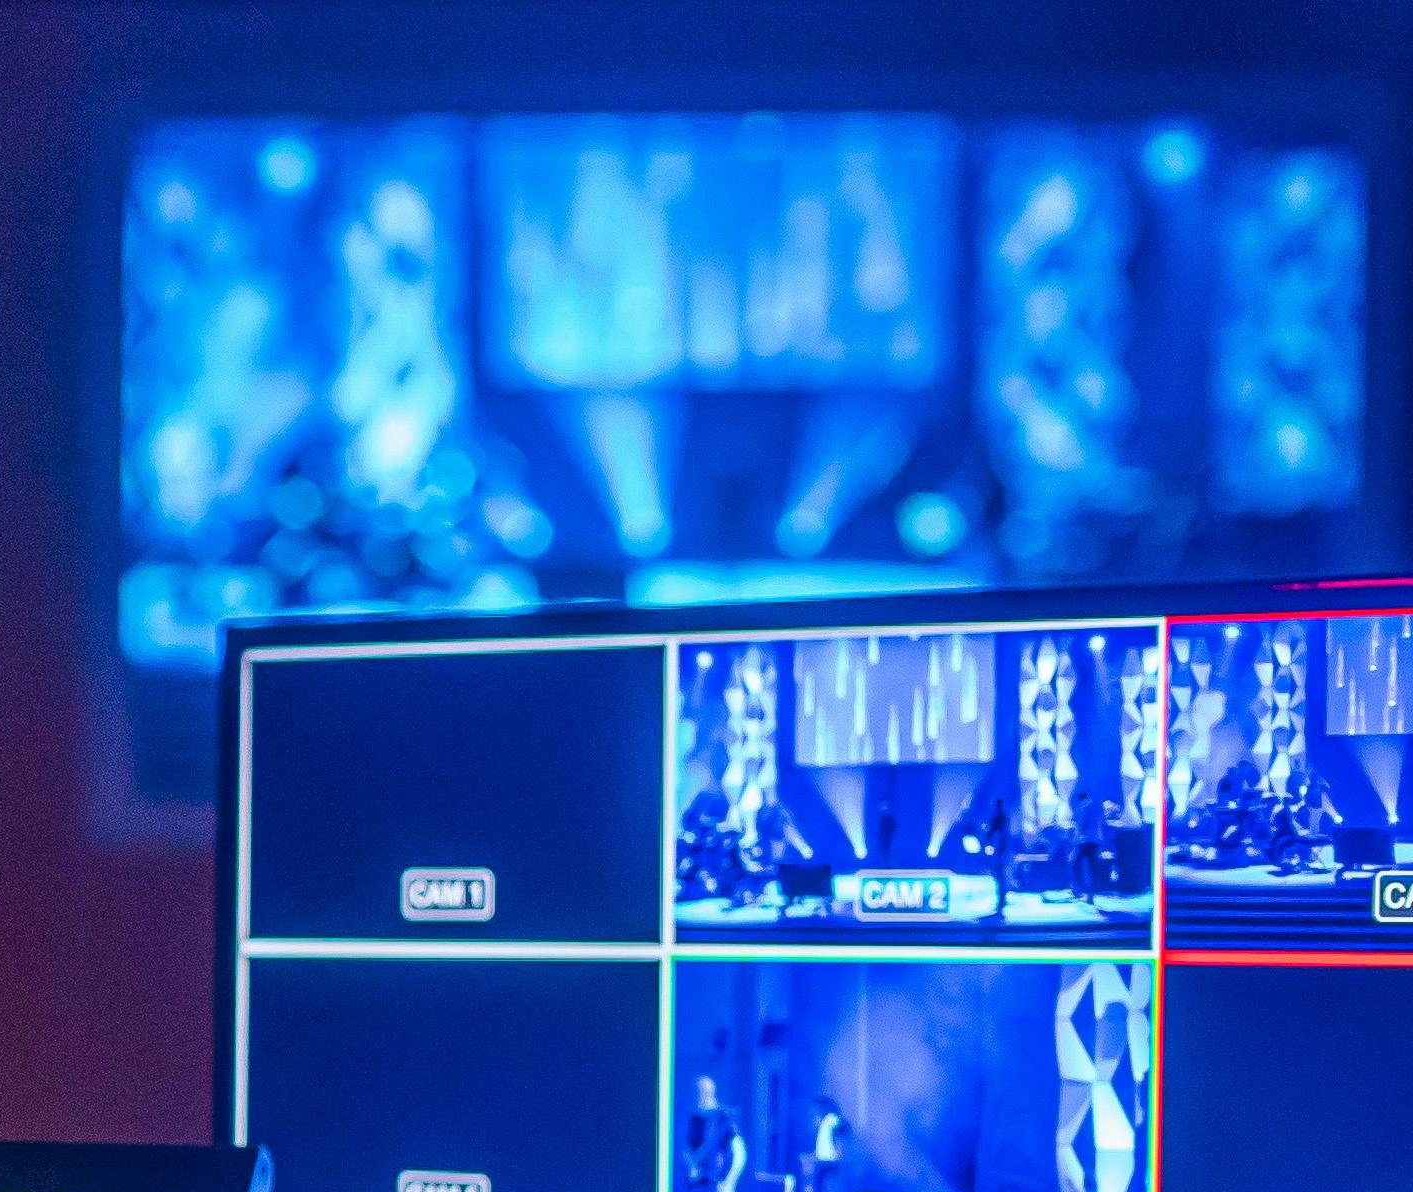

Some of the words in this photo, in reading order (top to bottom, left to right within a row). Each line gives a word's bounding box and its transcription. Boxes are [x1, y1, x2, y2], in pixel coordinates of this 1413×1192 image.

[409, 879, 466, 909] CAM
[863, 880, 923, 909] CAM
[928, 881, 947, 909] 2
